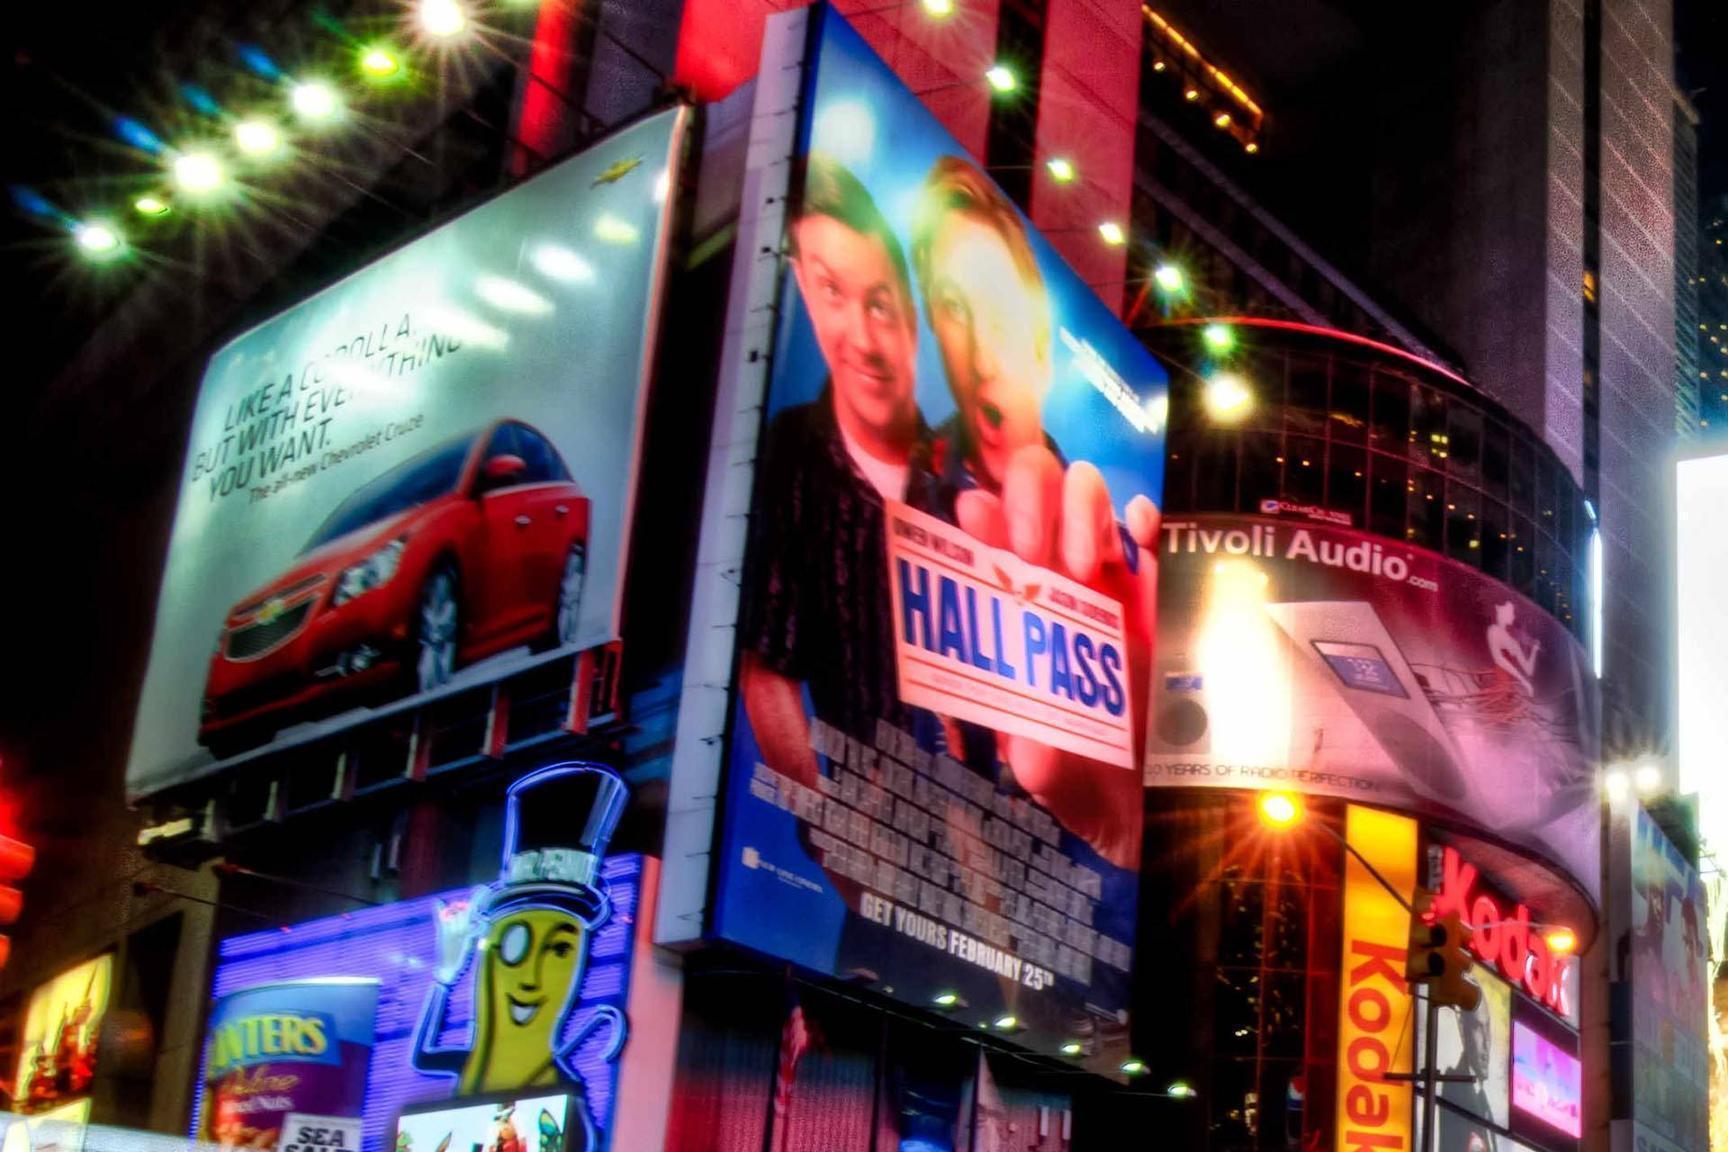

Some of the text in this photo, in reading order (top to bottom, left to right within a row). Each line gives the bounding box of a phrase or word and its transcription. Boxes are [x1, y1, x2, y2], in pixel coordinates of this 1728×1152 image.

[192, 333, 461, 482] BUT WITH EVETHIN
[223, 382, 275, 431] LIKE
[279, 374, 293, 399] A
[210, 418, 333, 501] YOU WANT.
[1162, 521, 1275, 558] Tivoli
[896, 556, 1126, 717] HALL PASS
[1165, 763, 1212, 776] YEARS
[1215, 763, 1235, 776] OF
[859, 891, 895, 926] GET
[895, 904, 948, 951] YOURS
[949, 929, 1023, 982] FEBRUARY
[1437, 845, 1571, 1016] Kodak
[296, 1125, 345, 1147] SEA
